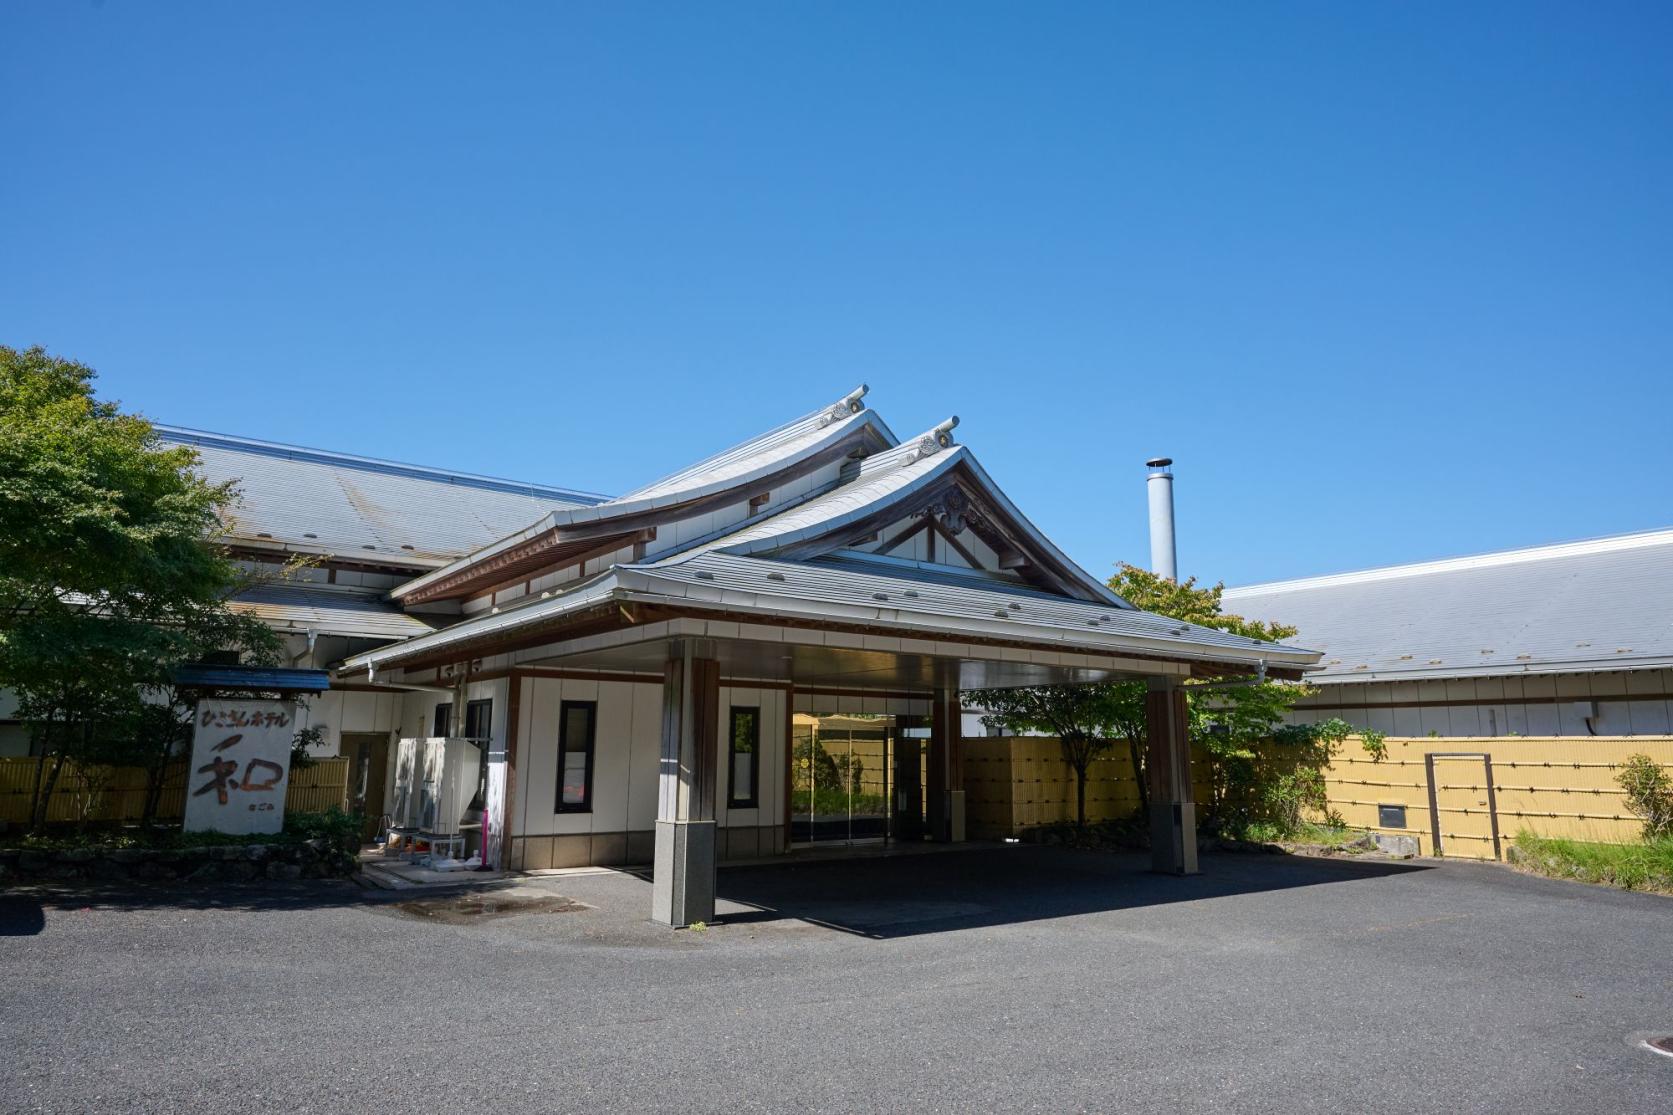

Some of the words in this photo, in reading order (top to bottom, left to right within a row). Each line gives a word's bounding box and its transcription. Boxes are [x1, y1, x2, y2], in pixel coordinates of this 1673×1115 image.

[201, 710, 289, 728] ひこさんホテル
[192, 734, 284, 805] 和
